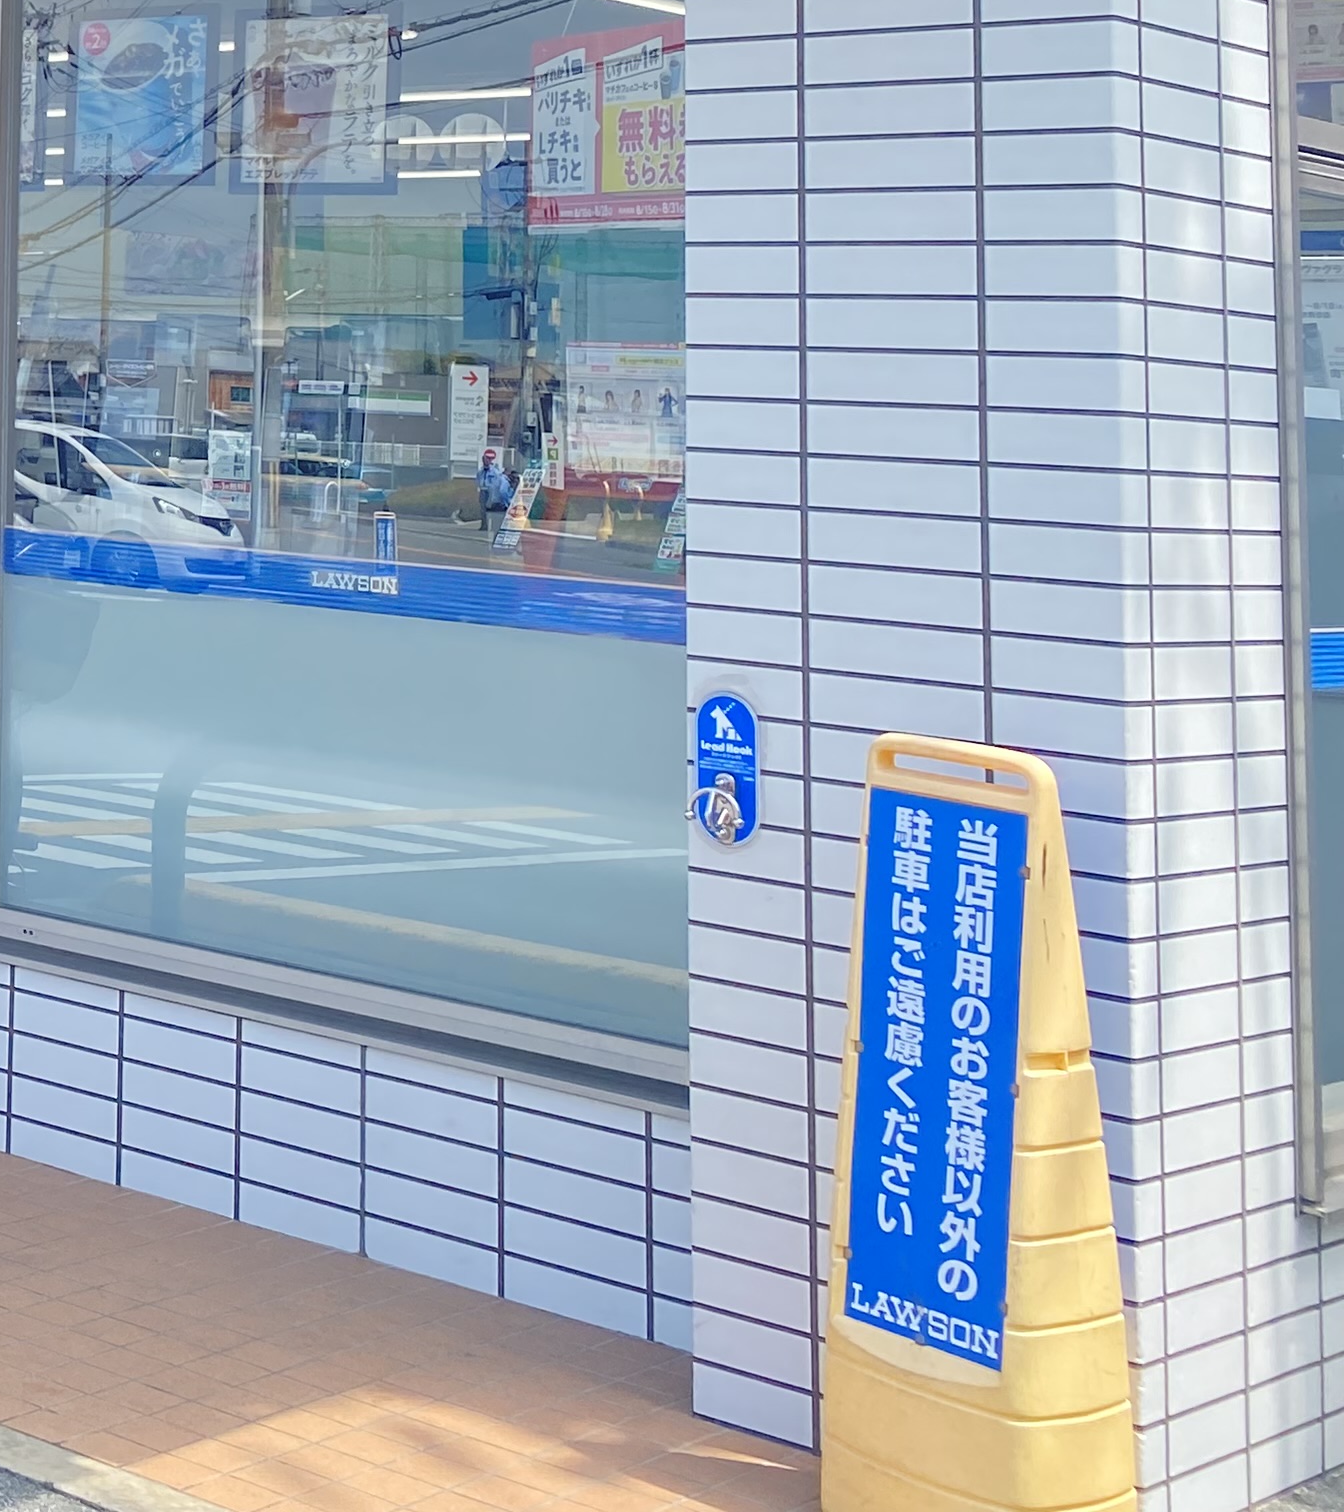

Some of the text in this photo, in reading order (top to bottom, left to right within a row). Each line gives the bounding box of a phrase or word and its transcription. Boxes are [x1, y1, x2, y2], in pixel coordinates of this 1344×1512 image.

[539, 129, 571, 155] Lチキ
[619, 105, 685, 154] 無料
[547, 158, 581, 185] 買うと
[312, 571, 399, 595] LAWSON
[701, 739, 754, 757] Lead Hook
[877, 806, 933, 1236] 駐車はご遠慮ください
[938, 818, 998, 1302] 当店利用のお客様以外の
[851, 1282, 1000, 1361] LAWSON
